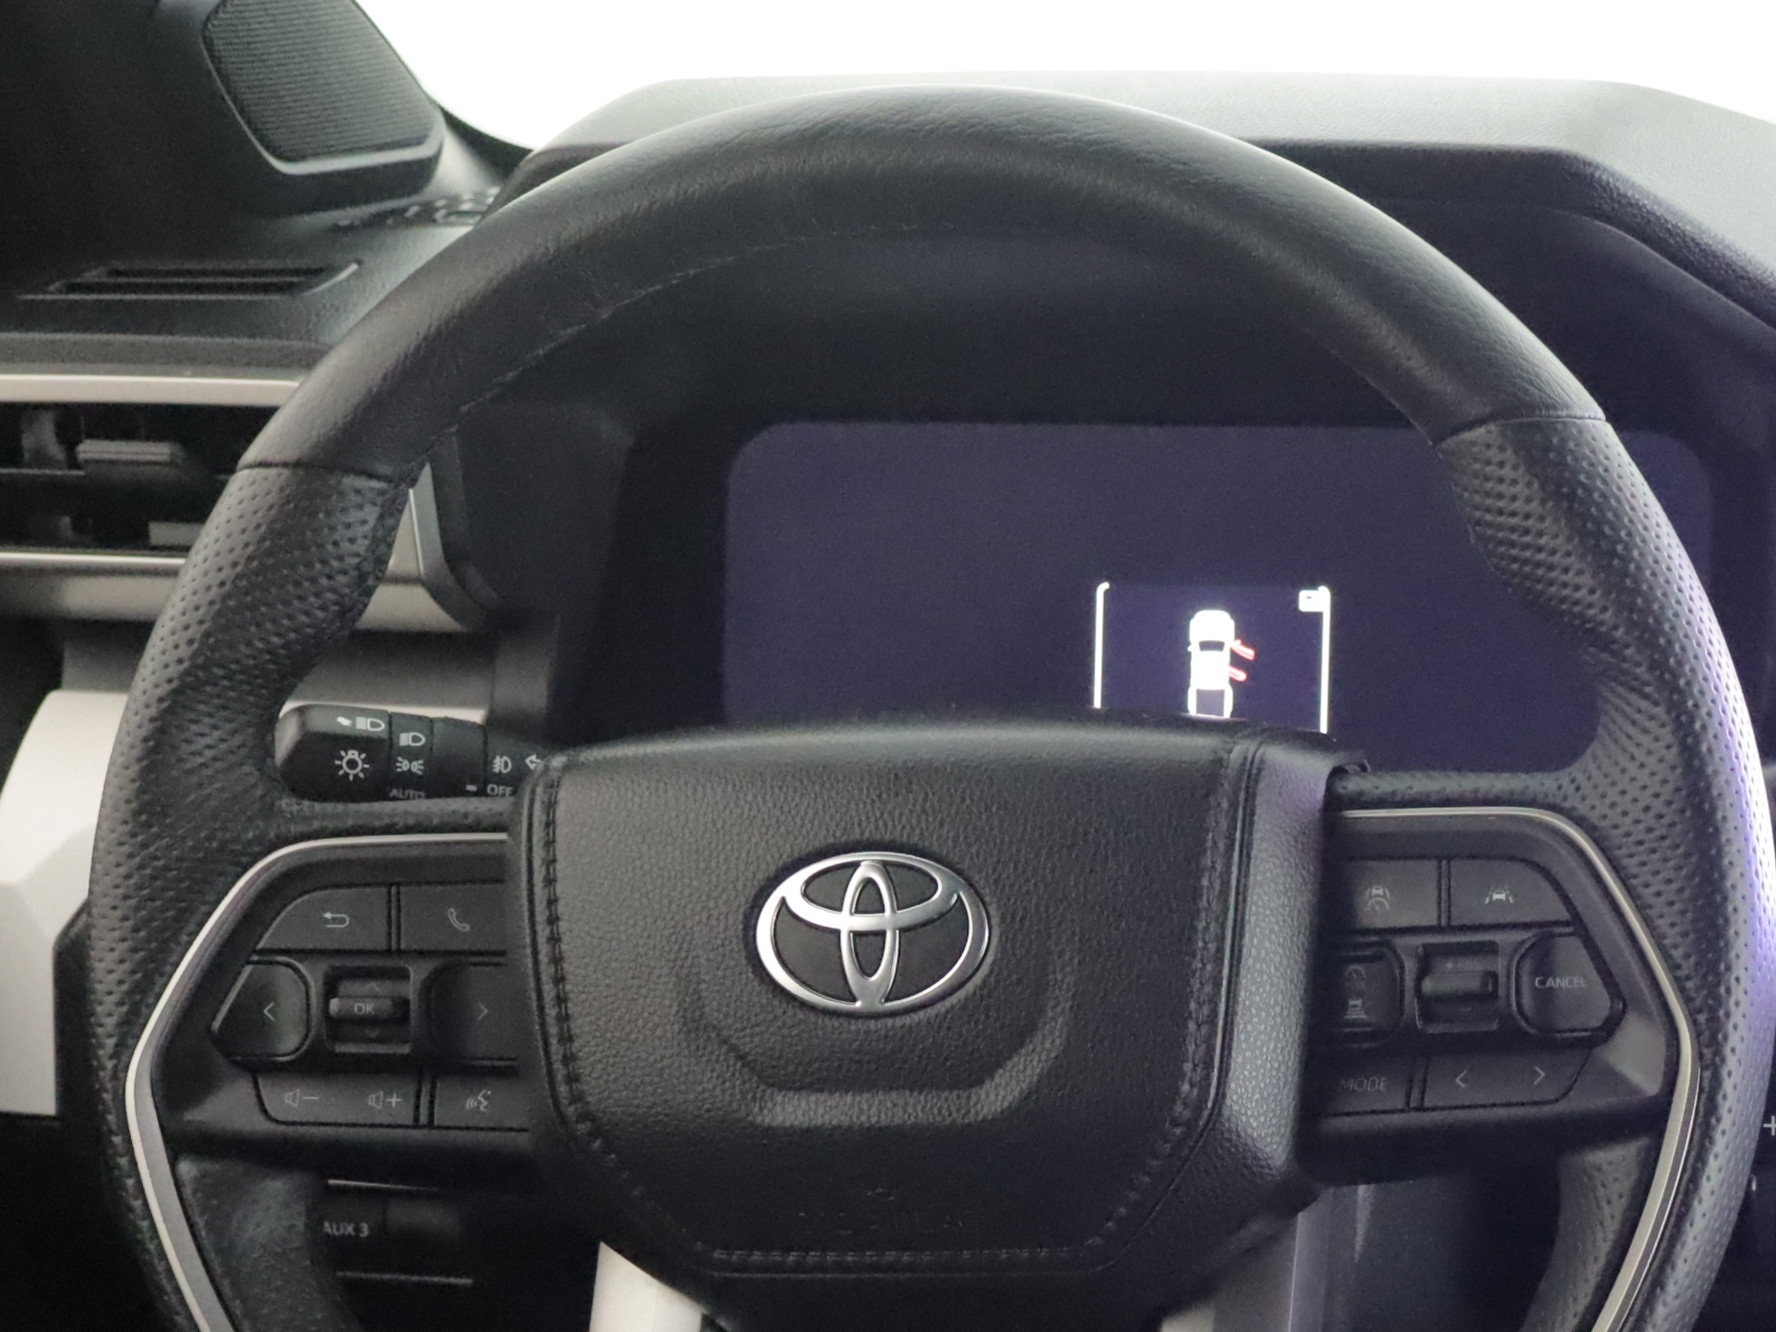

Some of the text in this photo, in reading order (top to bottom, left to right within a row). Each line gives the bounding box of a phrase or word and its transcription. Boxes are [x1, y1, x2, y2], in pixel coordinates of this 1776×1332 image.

[389, 787, 427, 800] AUTO
[486, 783, 514, 797] OFF
[1535, 976, 1587, 989] CANCEL
[354, 1003, 376, 1016] OK
[1340, 1077, 1388, 1092] MODE
[359, 1223, 370, 1238] 3
